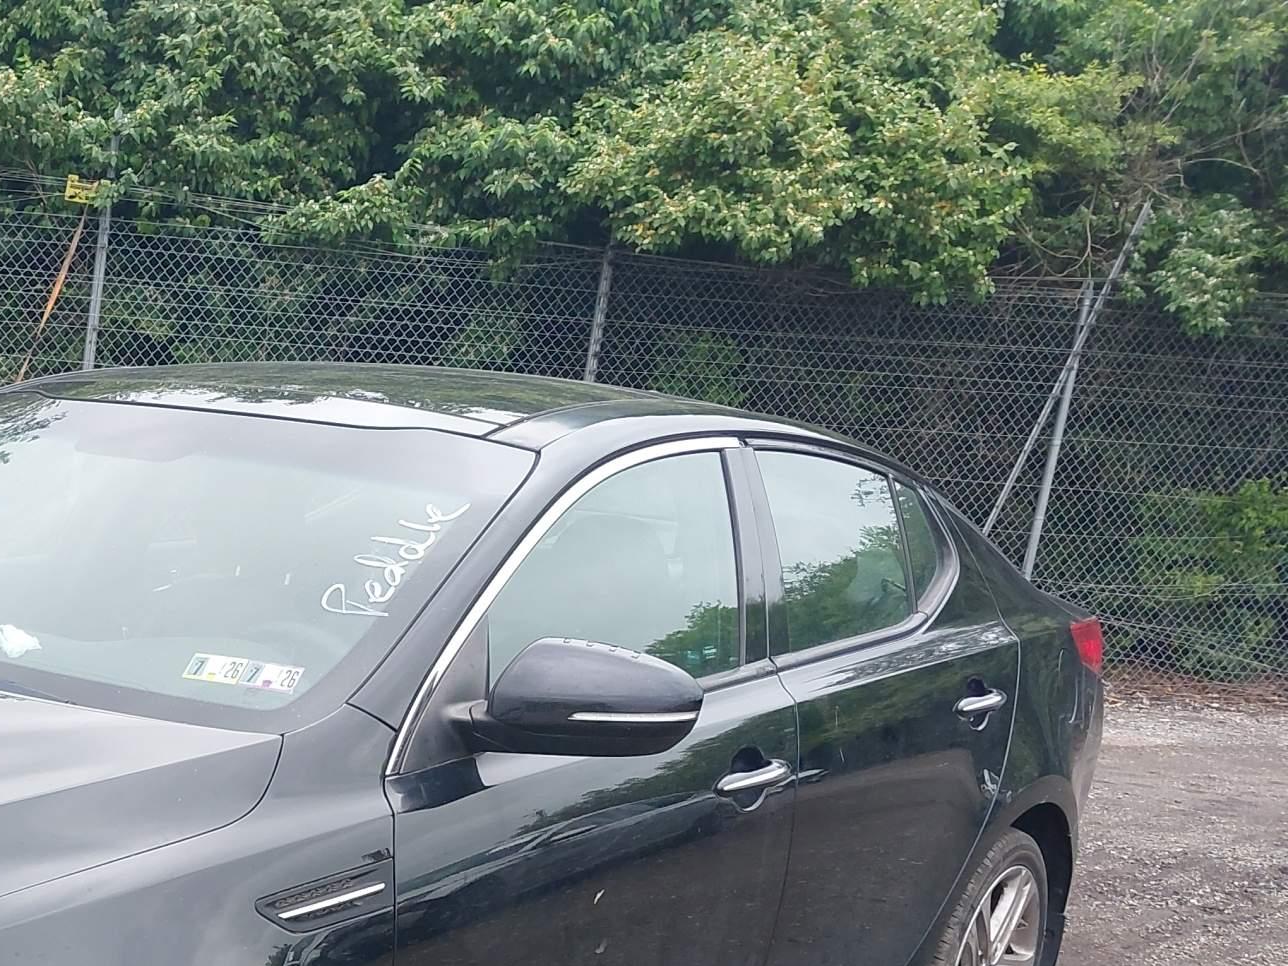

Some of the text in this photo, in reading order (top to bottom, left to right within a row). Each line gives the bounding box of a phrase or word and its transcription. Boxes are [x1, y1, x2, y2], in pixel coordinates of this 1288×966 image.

[193, 660, 243, 679] 7 26
[247, 666, 300, 688] 7 26
